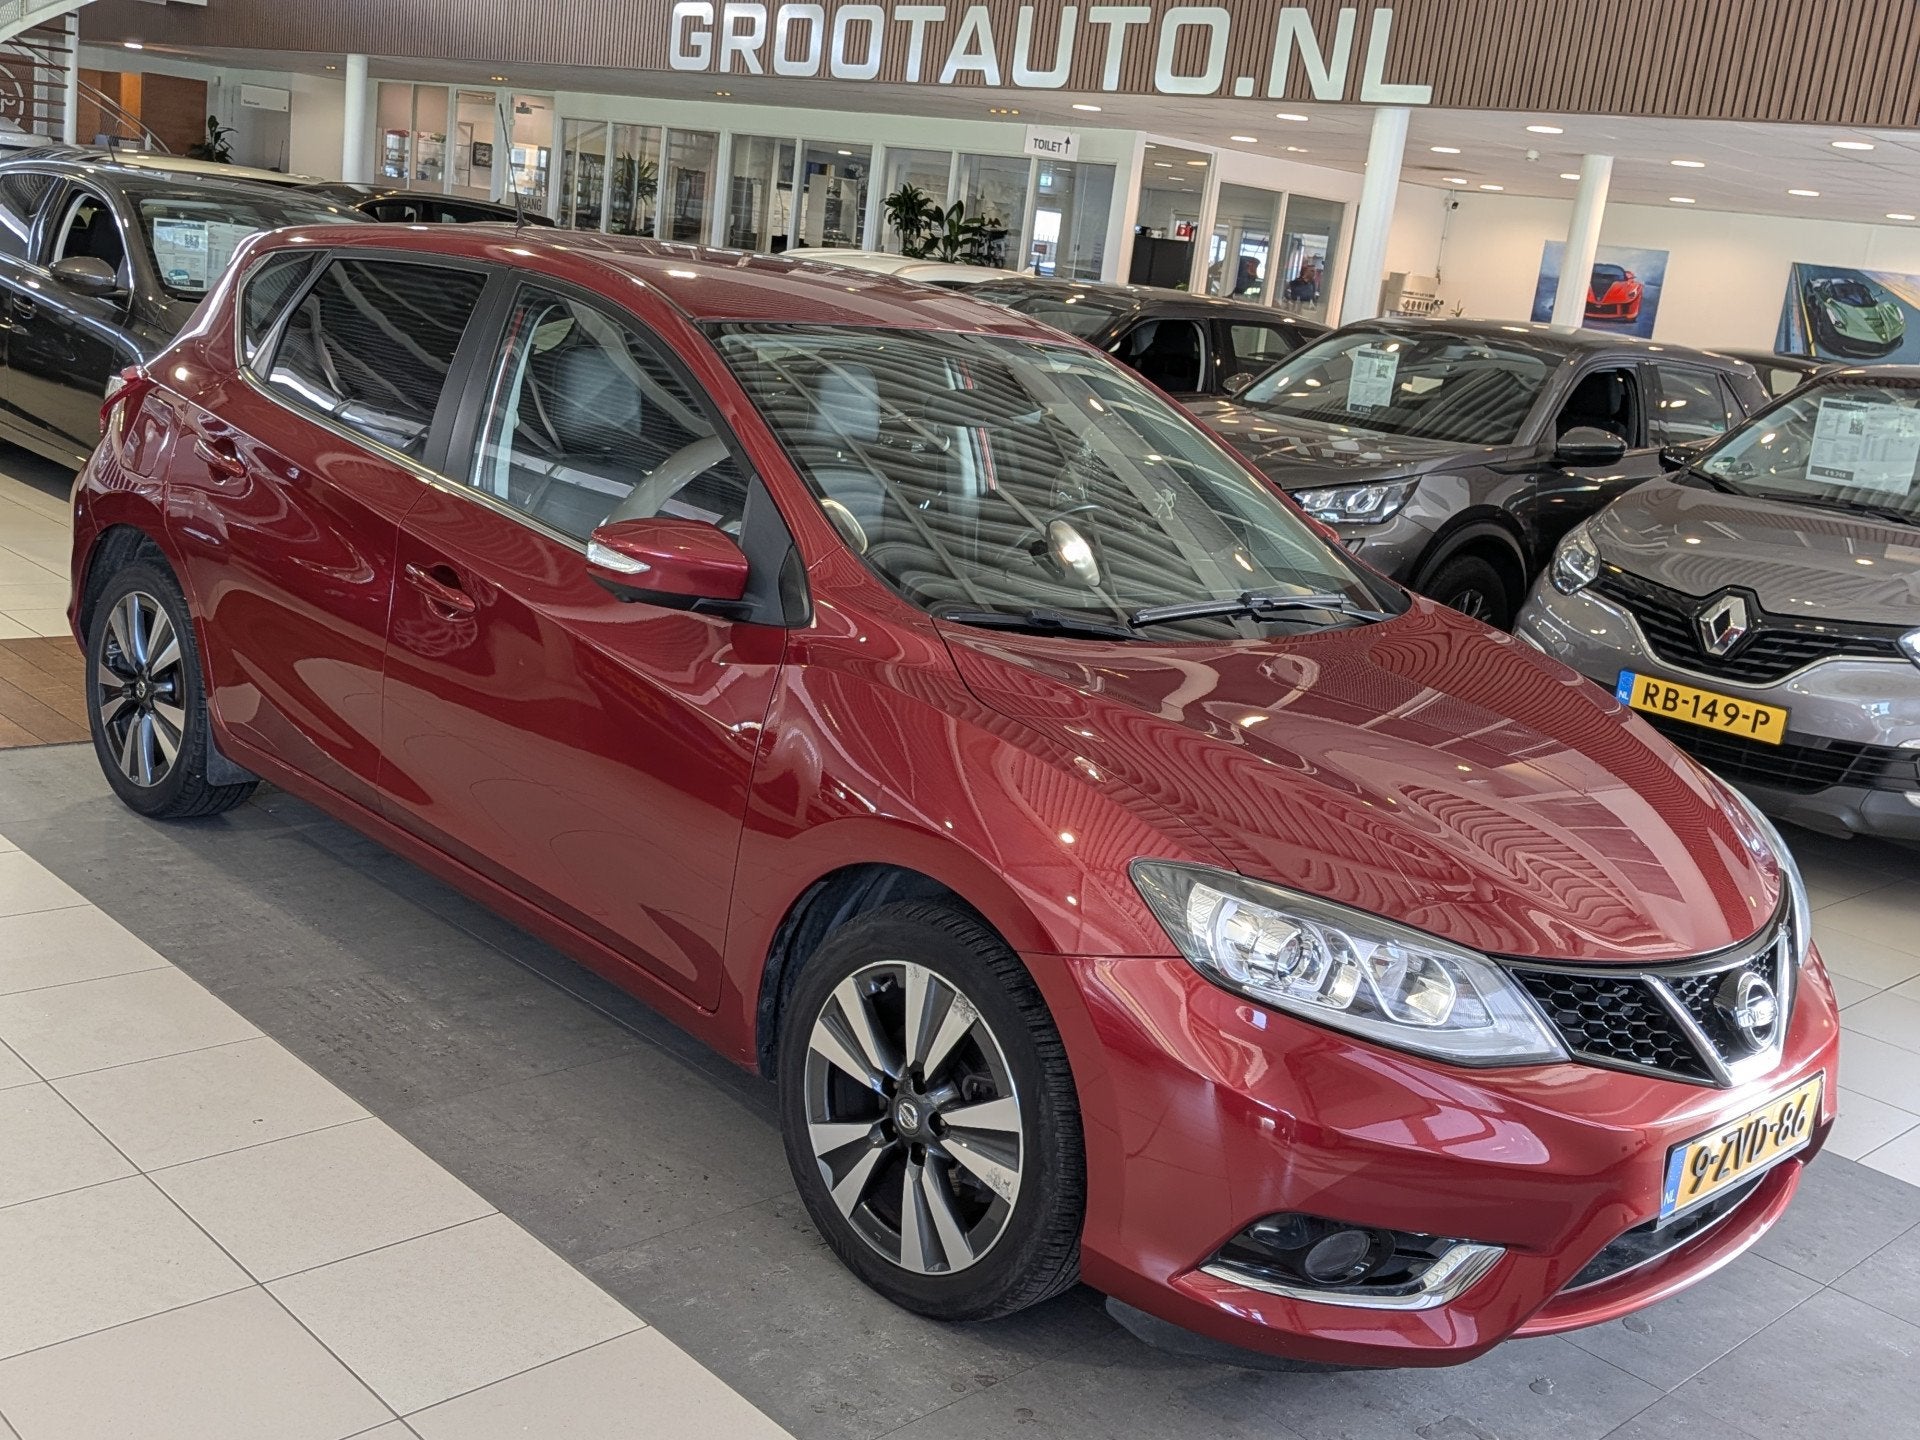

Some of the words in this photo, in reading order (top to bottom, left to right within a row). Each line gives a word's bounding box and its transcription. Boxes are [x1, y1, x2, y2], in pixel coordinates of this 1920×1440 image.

[669, 1, 1432, 104] GROOTAUTO.NL
[1033, 138, 1062, 153] TOILET
[1618, 690, 1629, 701] NL
[1642, 682, 1770, 733] RB-149-P
[1689, 1093, 1810, 1194] 9-ZVD-86
[1663, 1189, 1675, 1206] NL
